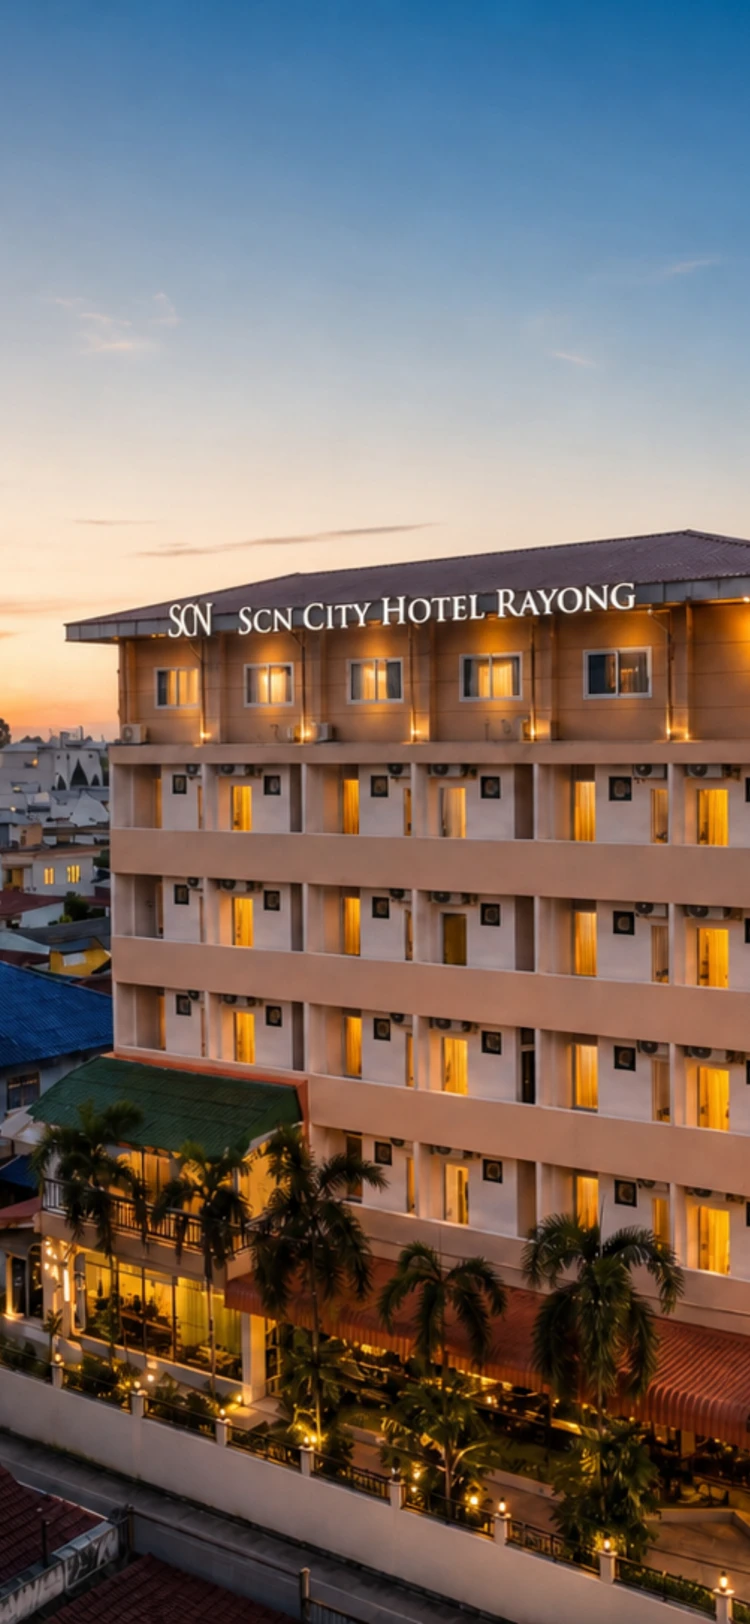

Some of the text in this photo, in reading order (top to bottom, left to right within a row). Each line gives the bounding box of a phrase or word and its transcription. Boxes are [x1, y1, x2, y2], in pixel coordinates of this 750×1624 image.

[303, 602, 371, 631] CITY
[381, 595, 485, 626] HOTEL
[496, 582, 636, 618] RAYONG
